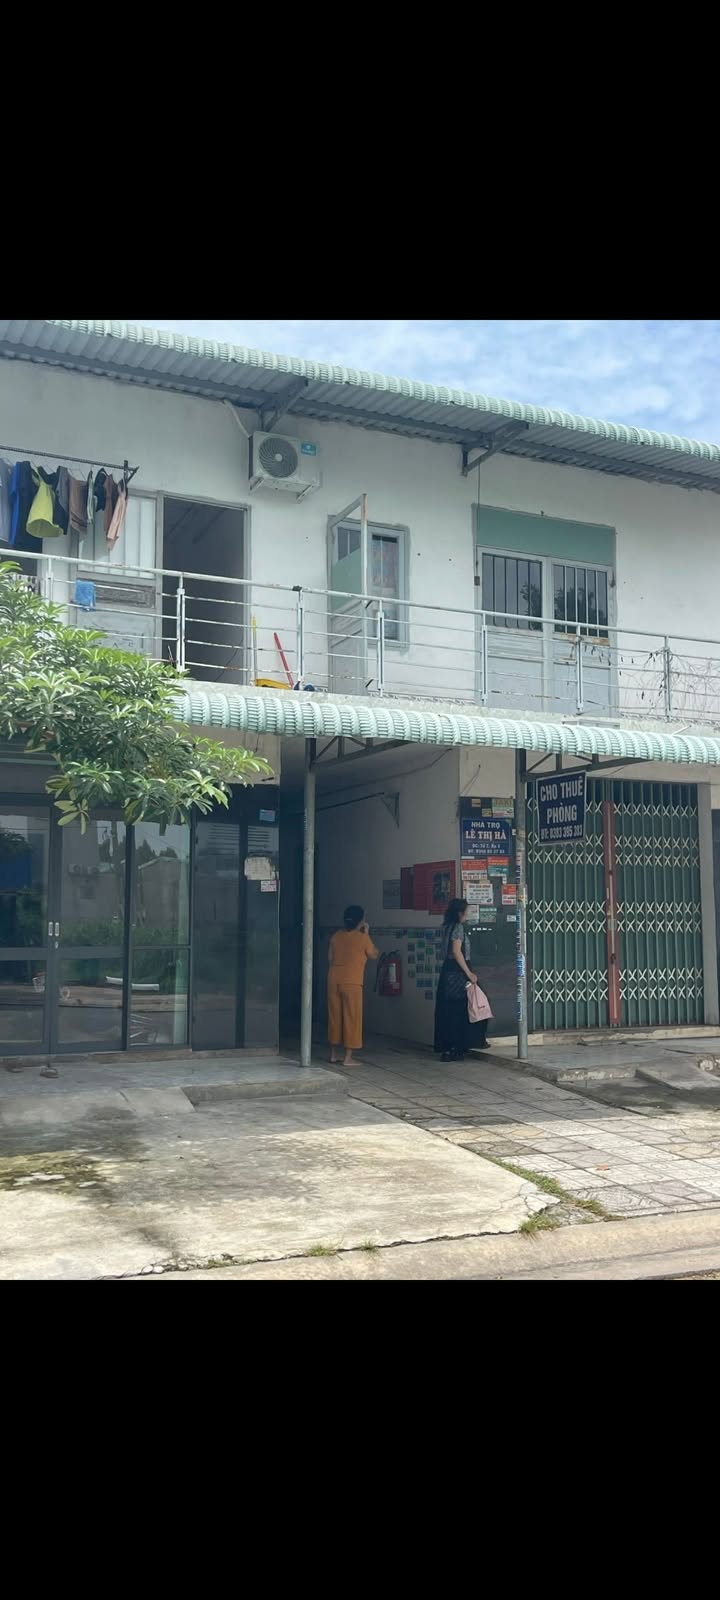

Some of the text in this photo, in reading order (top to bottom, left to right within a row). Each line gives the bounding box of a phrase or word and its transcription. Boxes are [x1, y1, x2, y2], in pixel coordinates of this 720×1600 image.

[540, 776, 584, 802] CHO THUÊ
[546, 802, 577, 825] PHÒNG
[465, 828, 476, 839] LÊ
[478, 830, 493, 841] THỊ
[487, 822, 501, 830] TRỌ
